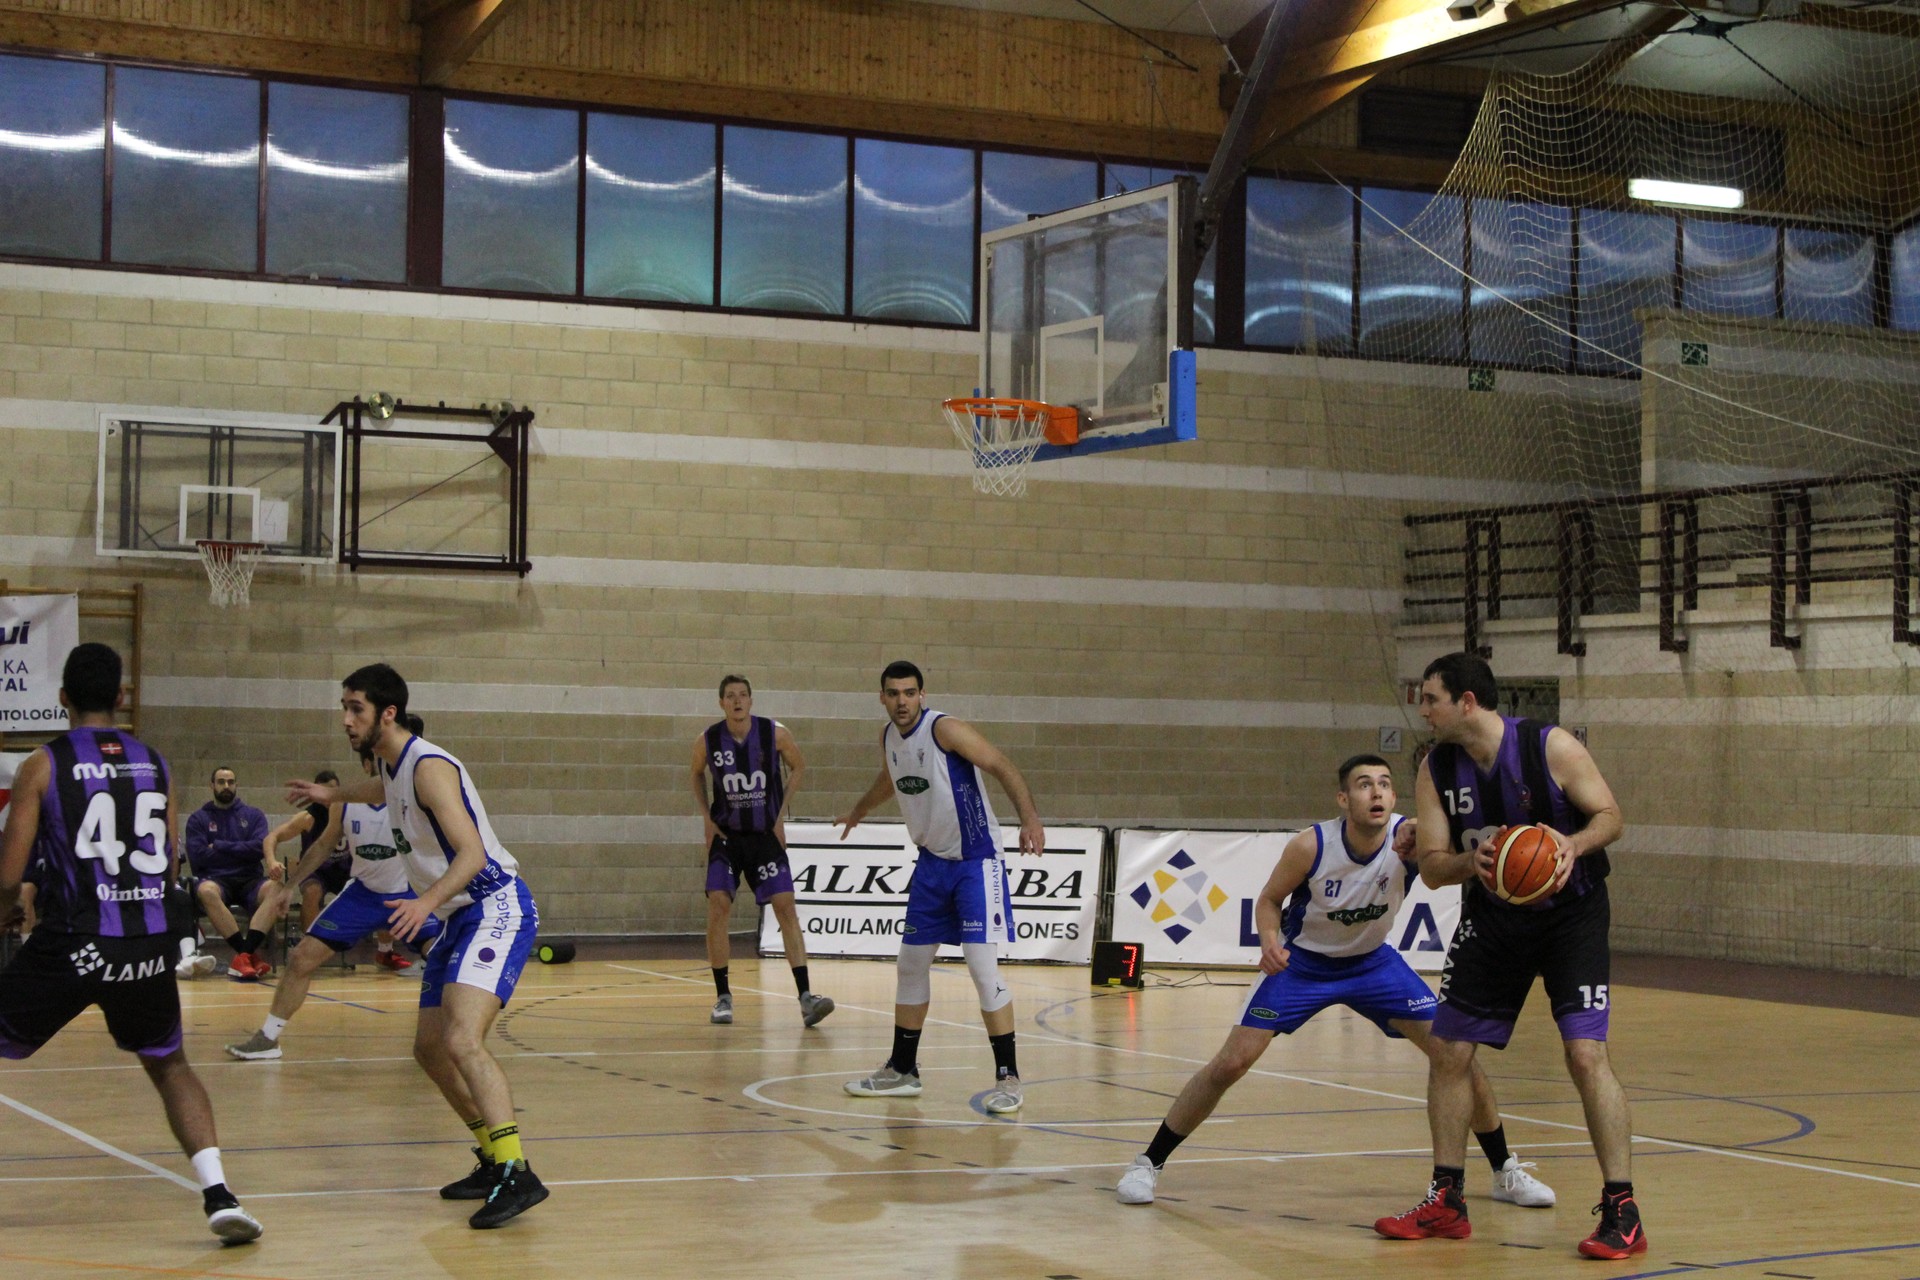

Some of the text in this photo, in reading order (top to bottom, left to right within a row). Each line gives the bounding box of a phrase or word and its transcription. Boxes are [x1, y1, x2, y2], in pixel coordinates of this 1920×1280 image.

[713, 751, 735, 767] 33
[1444, 786, 1475, 816] 15
[75, 792, 169, 876] 45
[351, 821, 360, 835] 10
[757, 861, 779, 880] 33
[991, 858, 1001, 904] DURANG
[1324, 880, 1342, 898] 27
[102, 955, 166, 982] LANA
[1407, 995, 1436, 1007] Azoka
[1578, 984, 1608, 1010] 15
